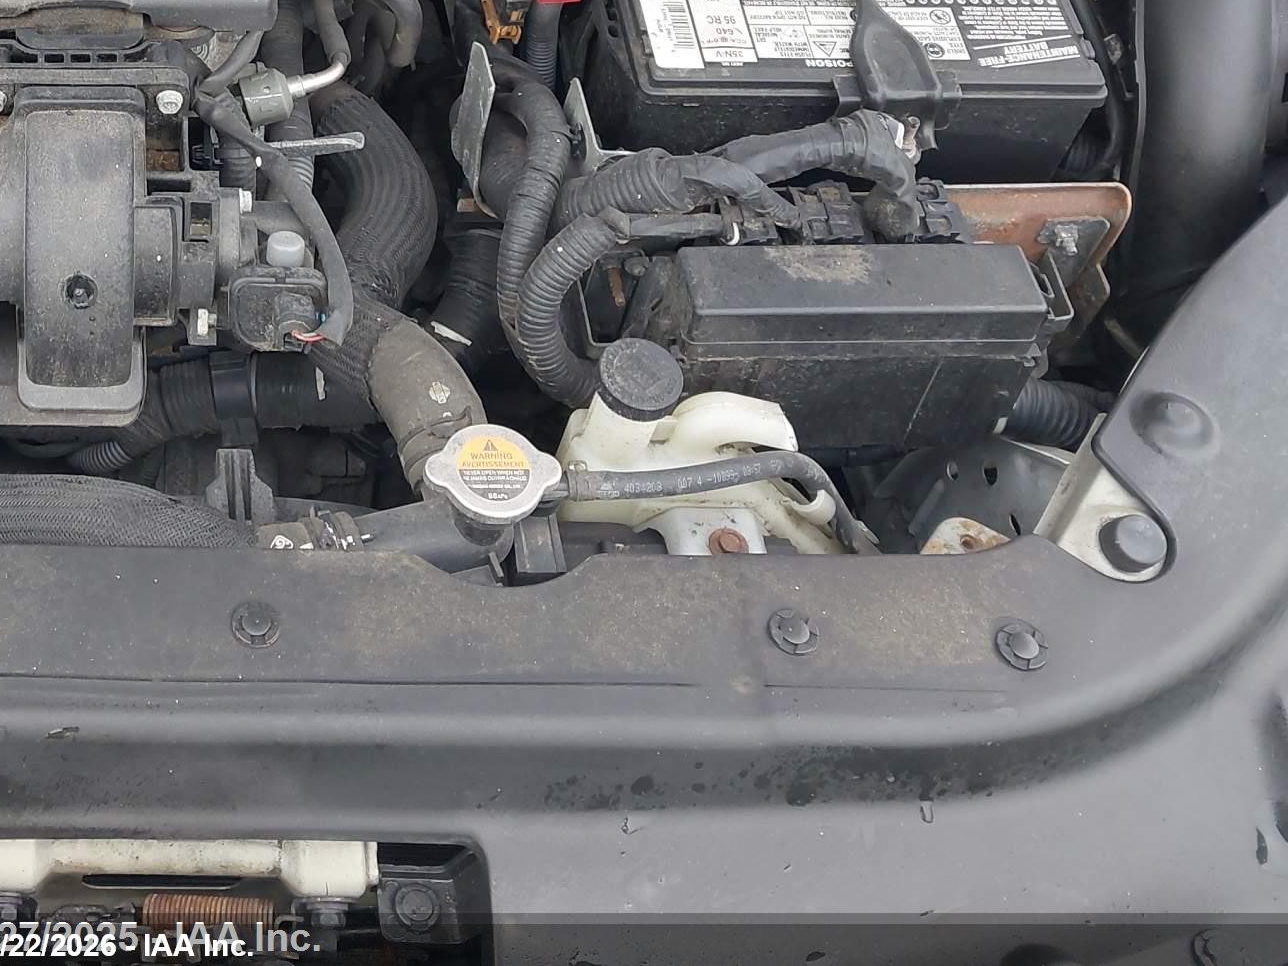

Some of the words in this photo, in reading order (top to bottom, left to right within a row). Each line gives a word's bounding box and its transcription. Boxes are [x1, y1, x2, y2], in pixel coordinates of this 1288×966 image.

[706, 15, 720, 24] RC
[723, 15, 736, 24] 95
[1004, 41, 1048, 54] BATTERY
[978, 45, 1079, 66] MAINTENANCE-FREE
[805, 59, 854, 67] POISON
[470, 452, 513, 460] WARNING
